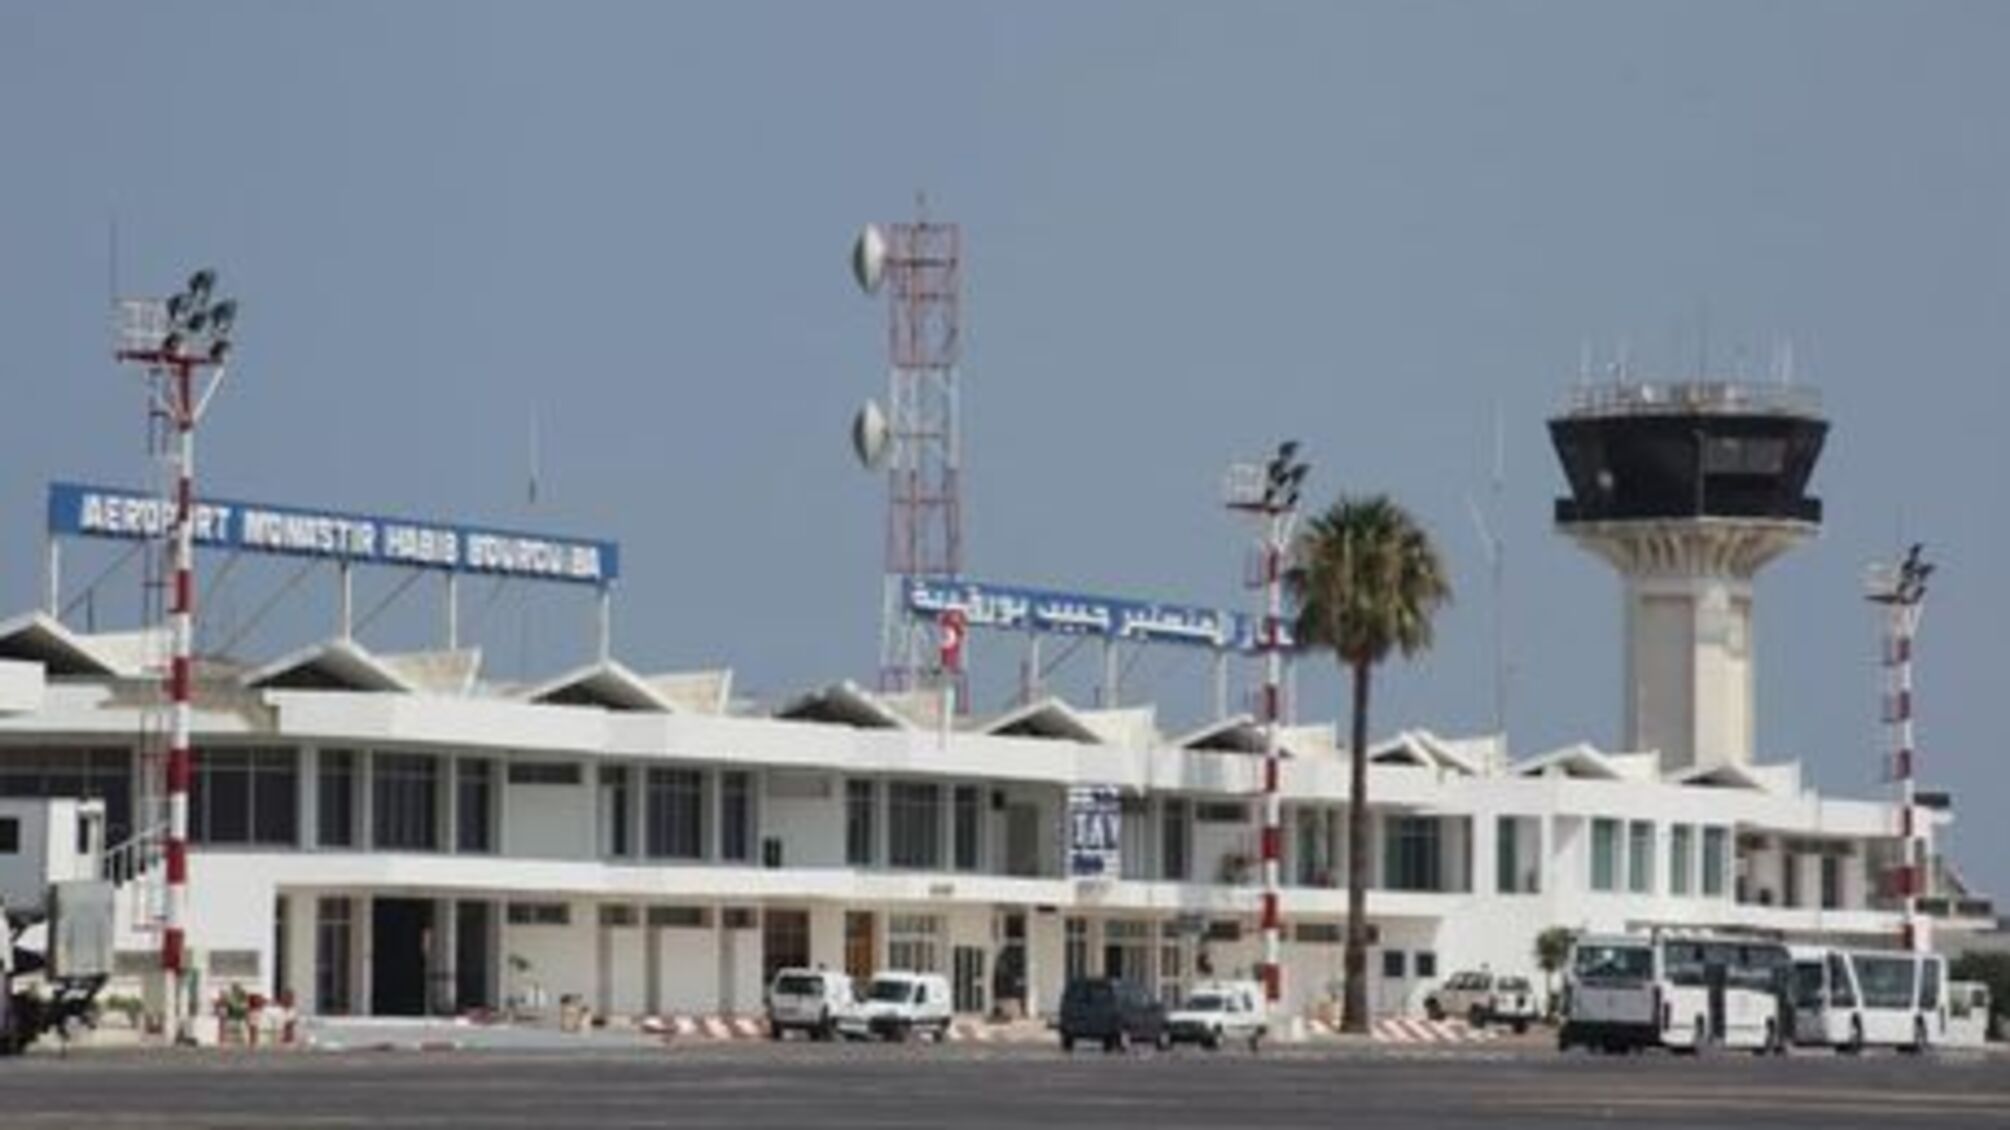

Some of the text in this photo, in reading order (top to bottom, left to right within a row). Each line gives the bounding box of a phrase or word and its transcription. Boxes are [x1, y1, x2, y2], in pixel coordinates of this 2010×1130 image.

[80, 494, 230, 541] AEROPRT
[385, 525, 458, 563] HABIB
[467, 533, 600, 580] BOURUBA
